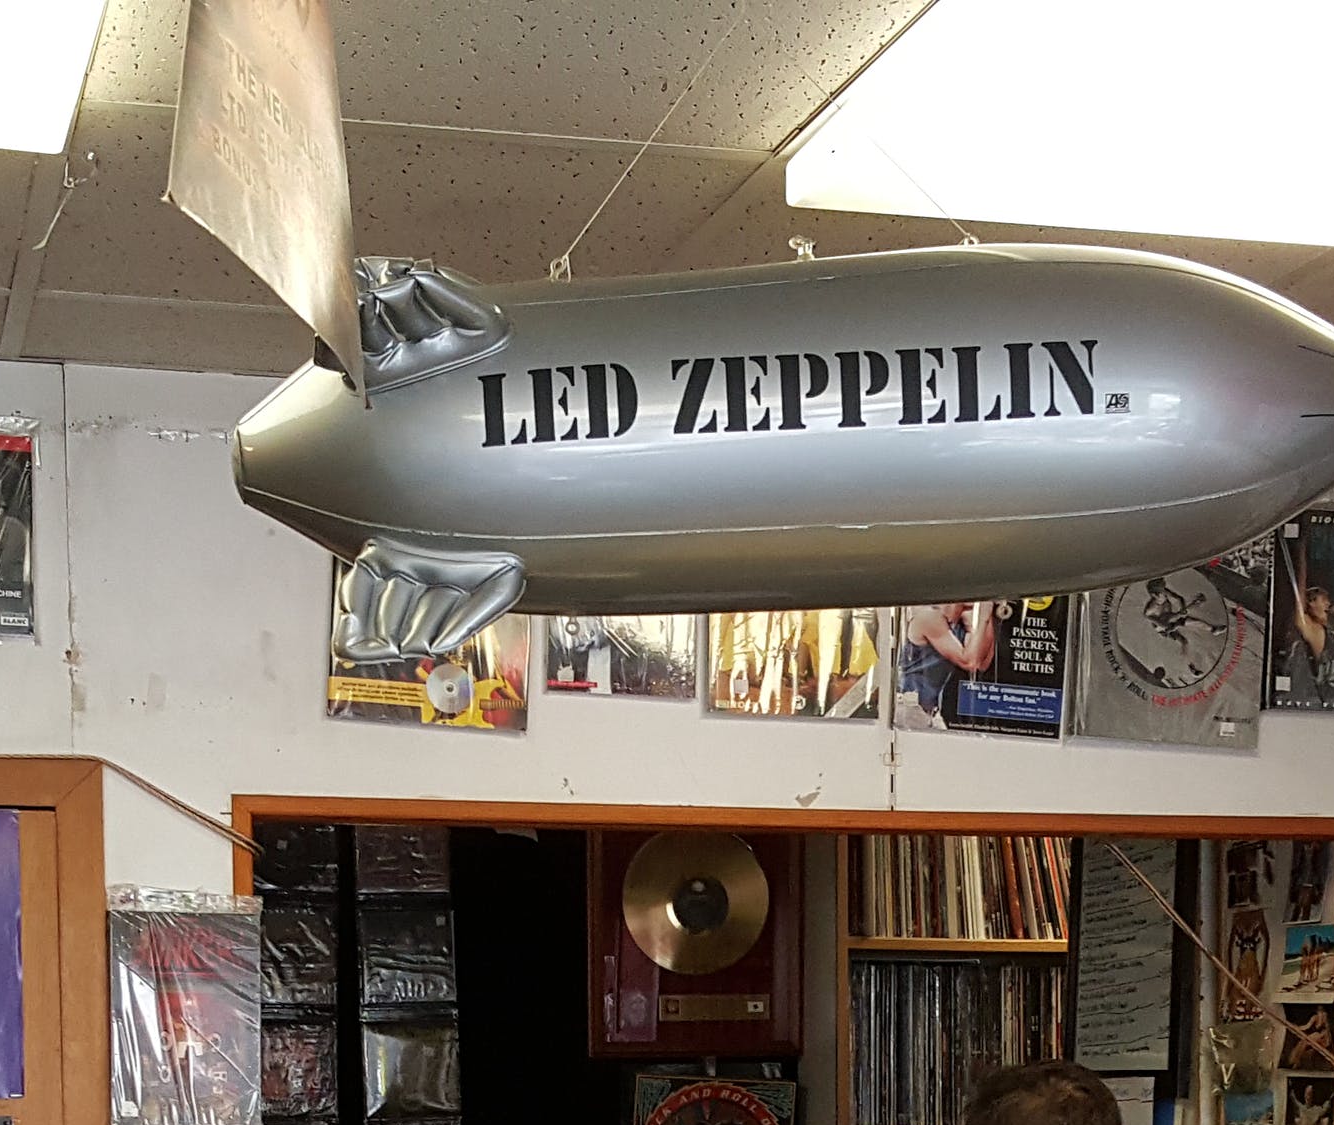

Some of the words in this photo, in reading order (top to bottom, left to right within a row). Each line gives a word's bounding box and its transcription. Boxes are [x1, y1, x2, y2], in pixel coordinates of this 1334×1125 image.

[478, 362, 638, 448] LED
[671, 339, 1099, 436] ZEPPELIN
[1026, 617, 1047, 627] THE
[1012, 627, 1058, 641] PASSION,
[1014, 651, 1042, 662] SOUL
[1044, 653, 1053, 662] &
[1012, 662, 1054, 674] TRUTHS
